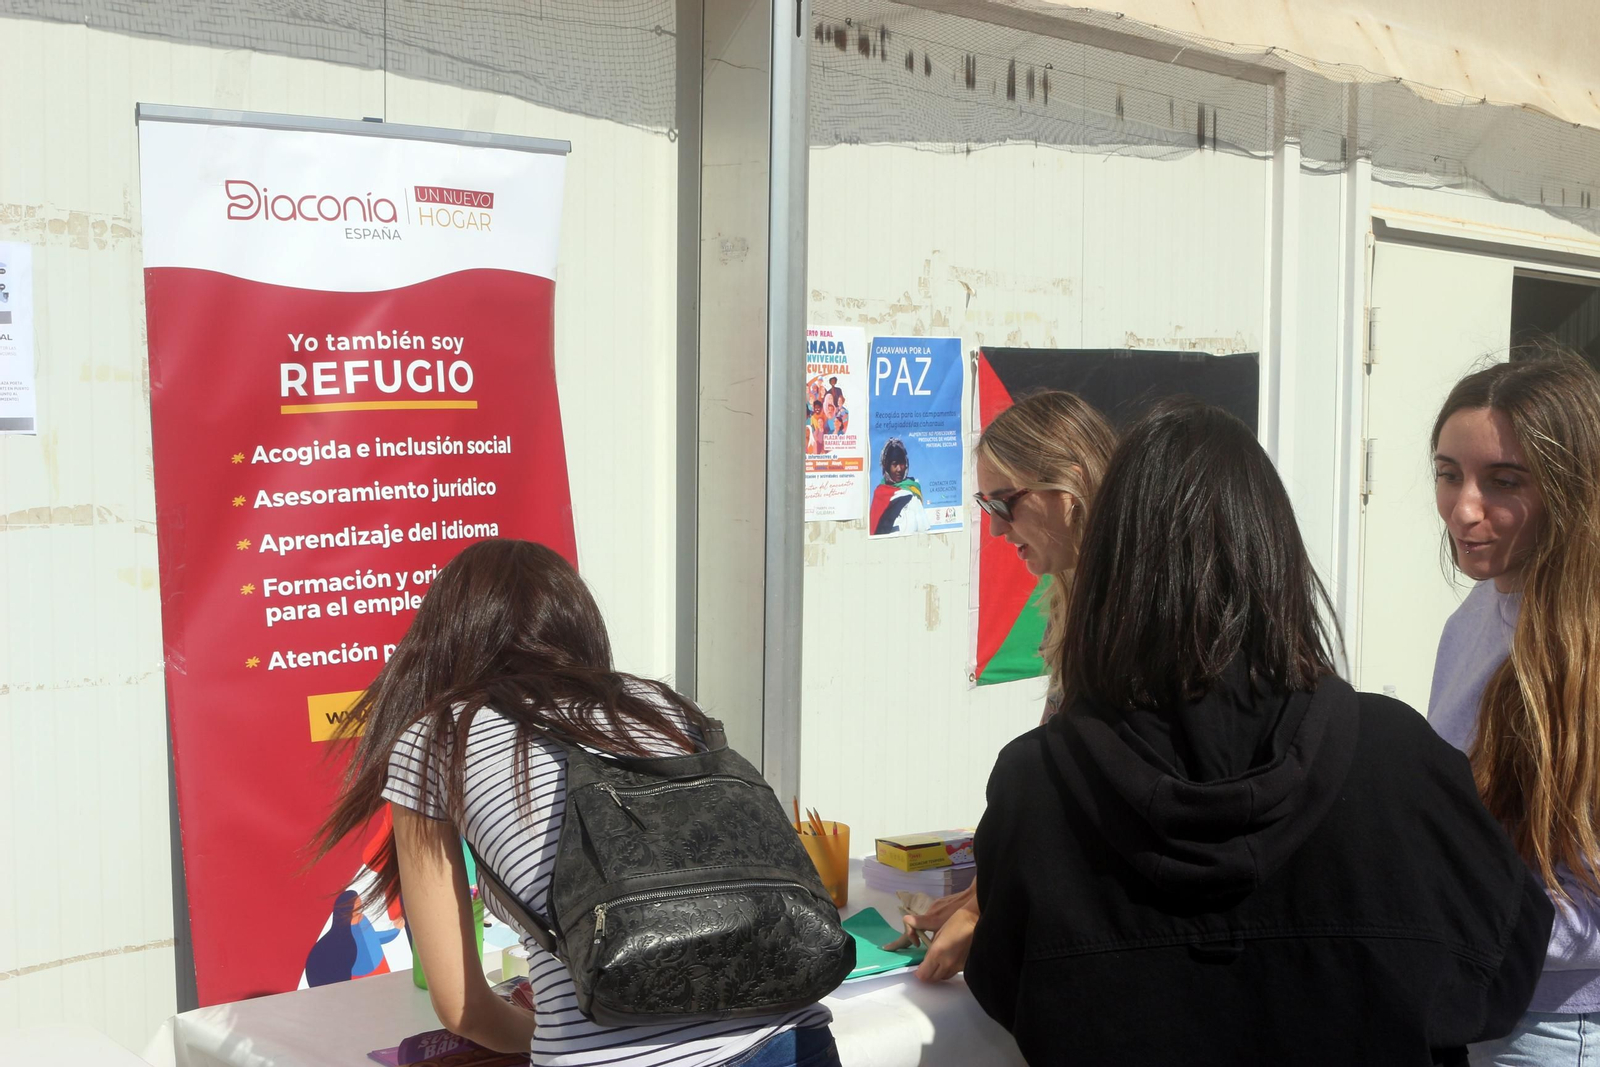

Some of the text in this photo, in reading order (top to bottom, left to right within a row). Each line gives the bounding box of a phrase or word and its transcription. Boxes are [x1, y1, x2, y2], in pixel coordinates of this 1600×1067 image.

[225, 180, 398, 224] Diaconía
[416, 187, 492, 208] UN NUEVO
[344, 226, 402, 241] ESPAÑA
[418, 207, 492, 232] HOGAR
[287, 330, 464, 355] Yo también soy
[875, 346, 932, 355] CARAVANA POR LA
[280, 359, 474, 397] REFUGIO
[875, 356, 932, 396] PAZ
[901, 411, 913, 419] para
[251, 436, 511, 466] Acogida e inclusión social
[253, 476, 497, 509] Asesoramiento jurídico
[259, 520, 499, 556] Aprendizaje del idioma
[263, 563, 443, 597] Formación y ori
[265, 590, 427, 627] para el emple
[267, 642, 378, 671] Atención
